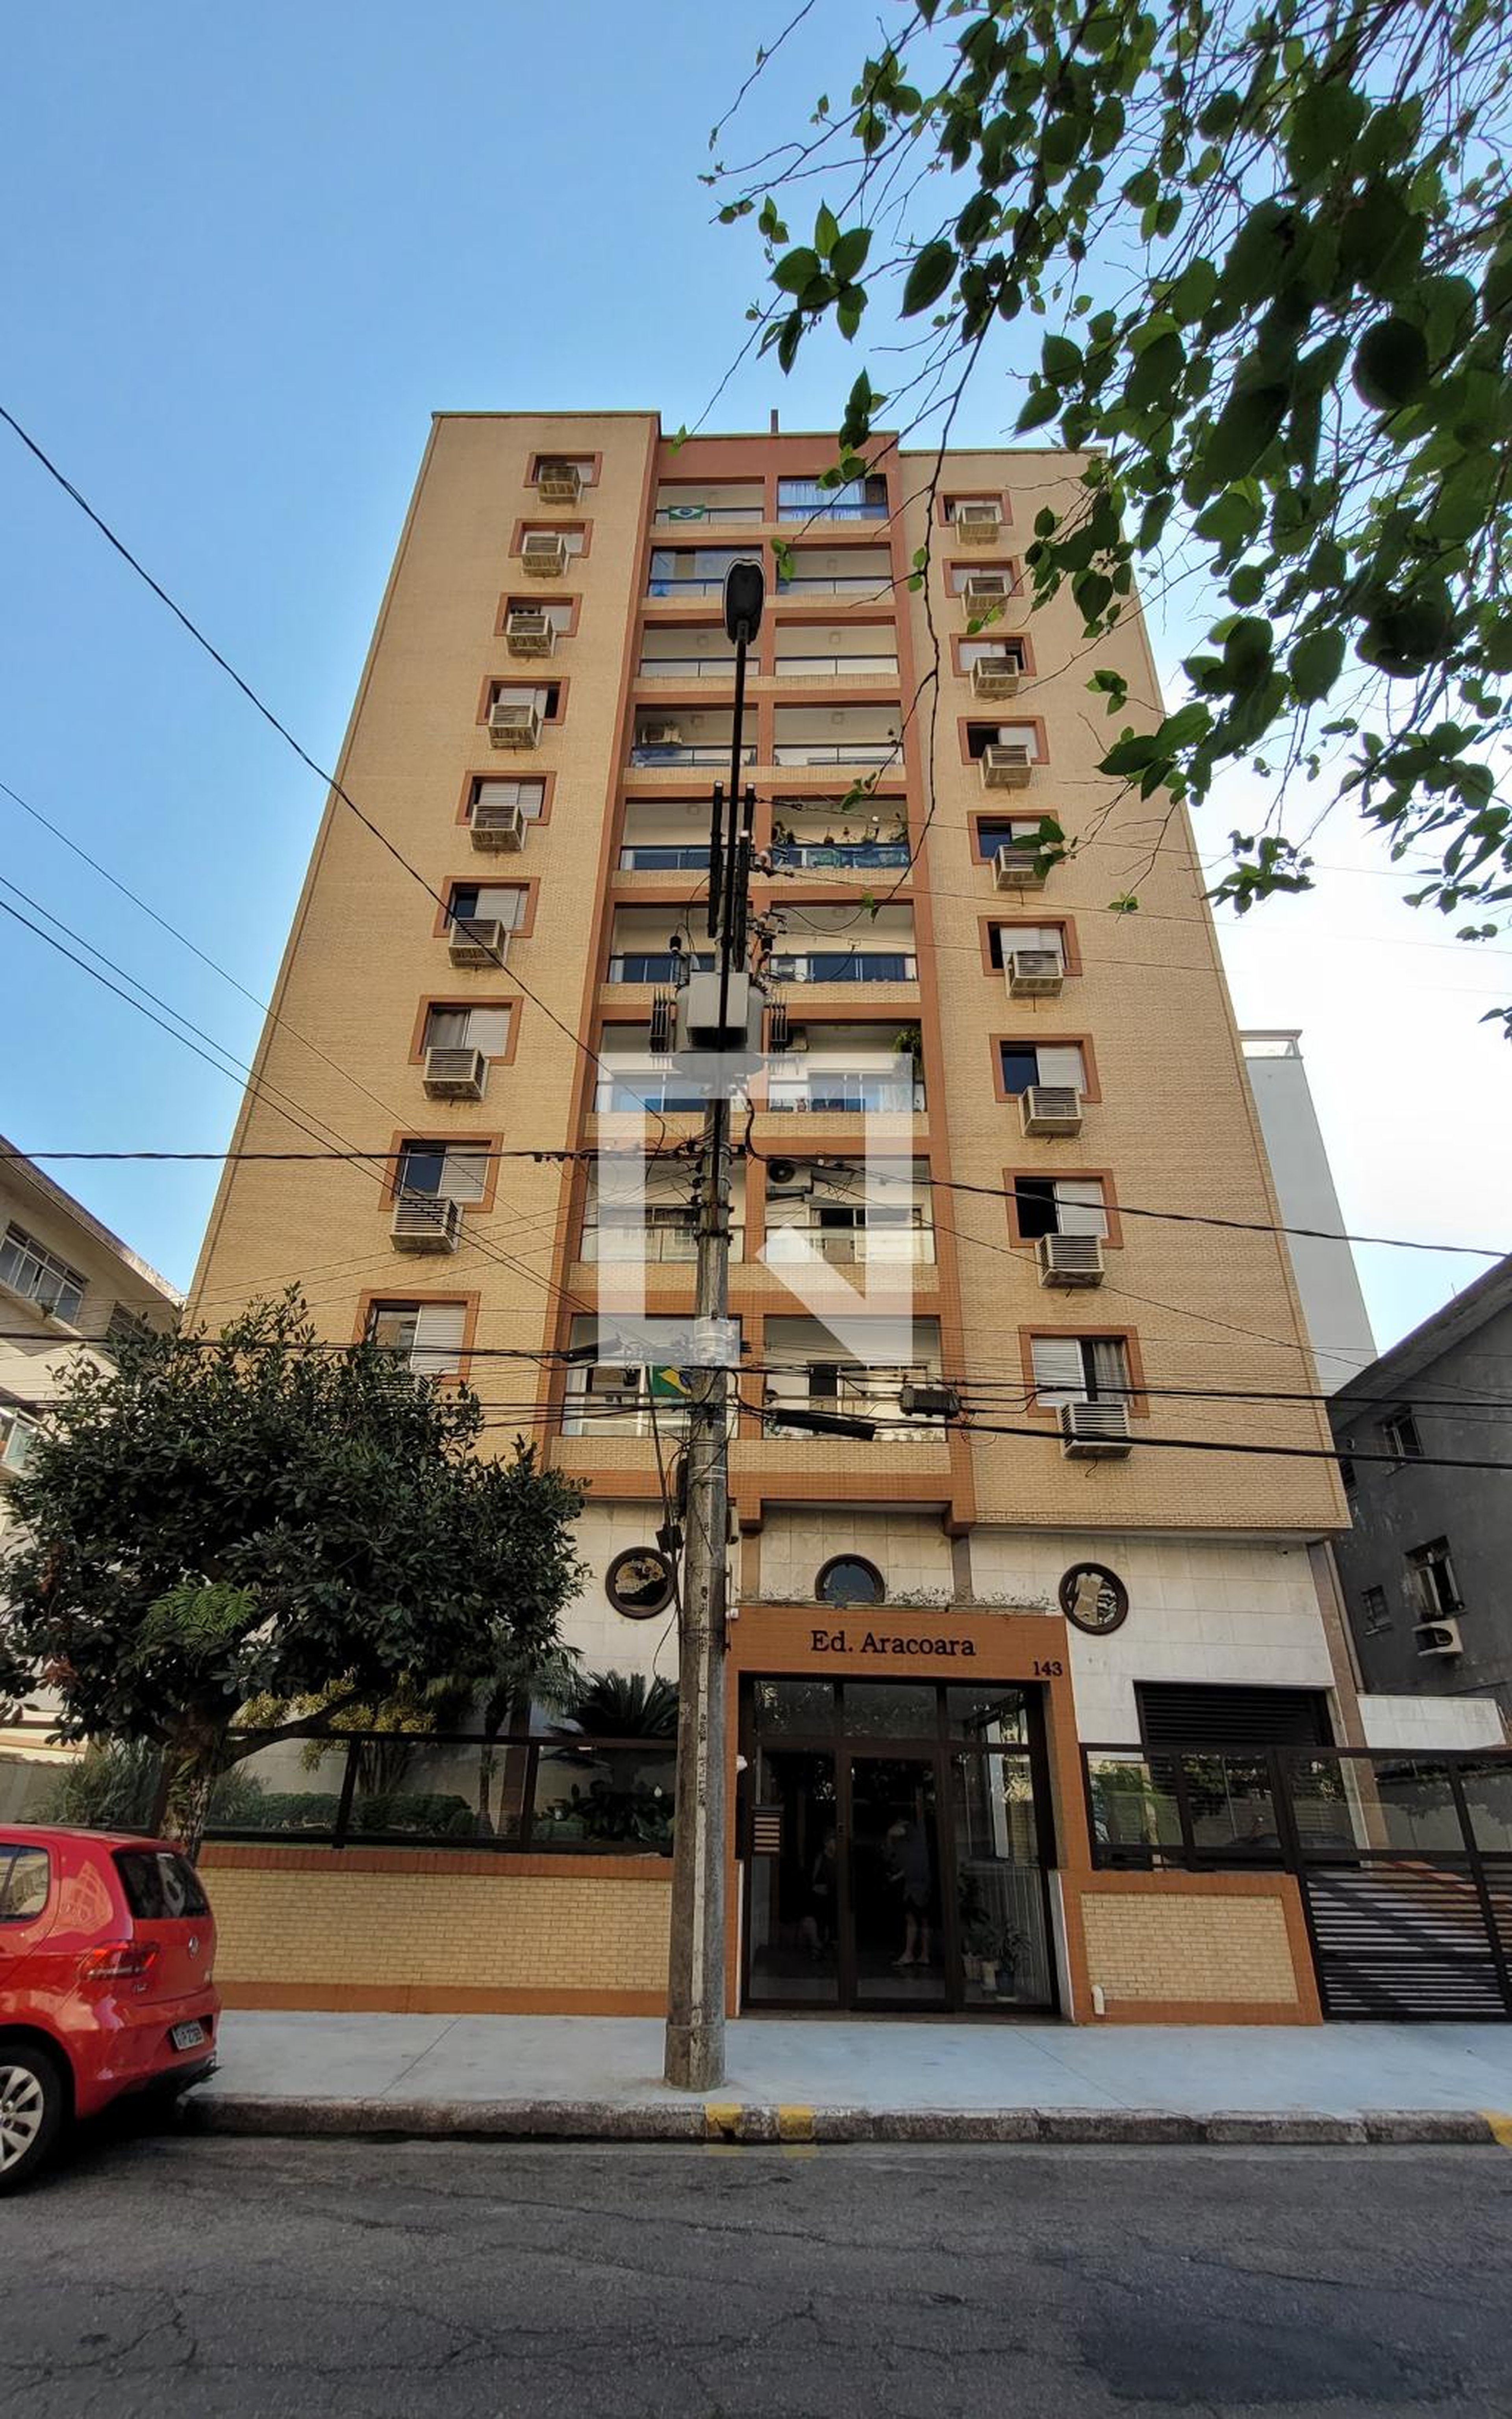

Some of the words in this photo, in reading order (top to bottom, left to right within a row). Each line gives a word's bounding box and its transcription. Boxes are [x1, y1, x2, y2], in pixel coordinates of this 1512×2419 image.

[811, 1630, 853, 1652] Ed.
[860, 1632, 976, 1655] Aracoara
[1034, 1661, 1063, 1676] 143
